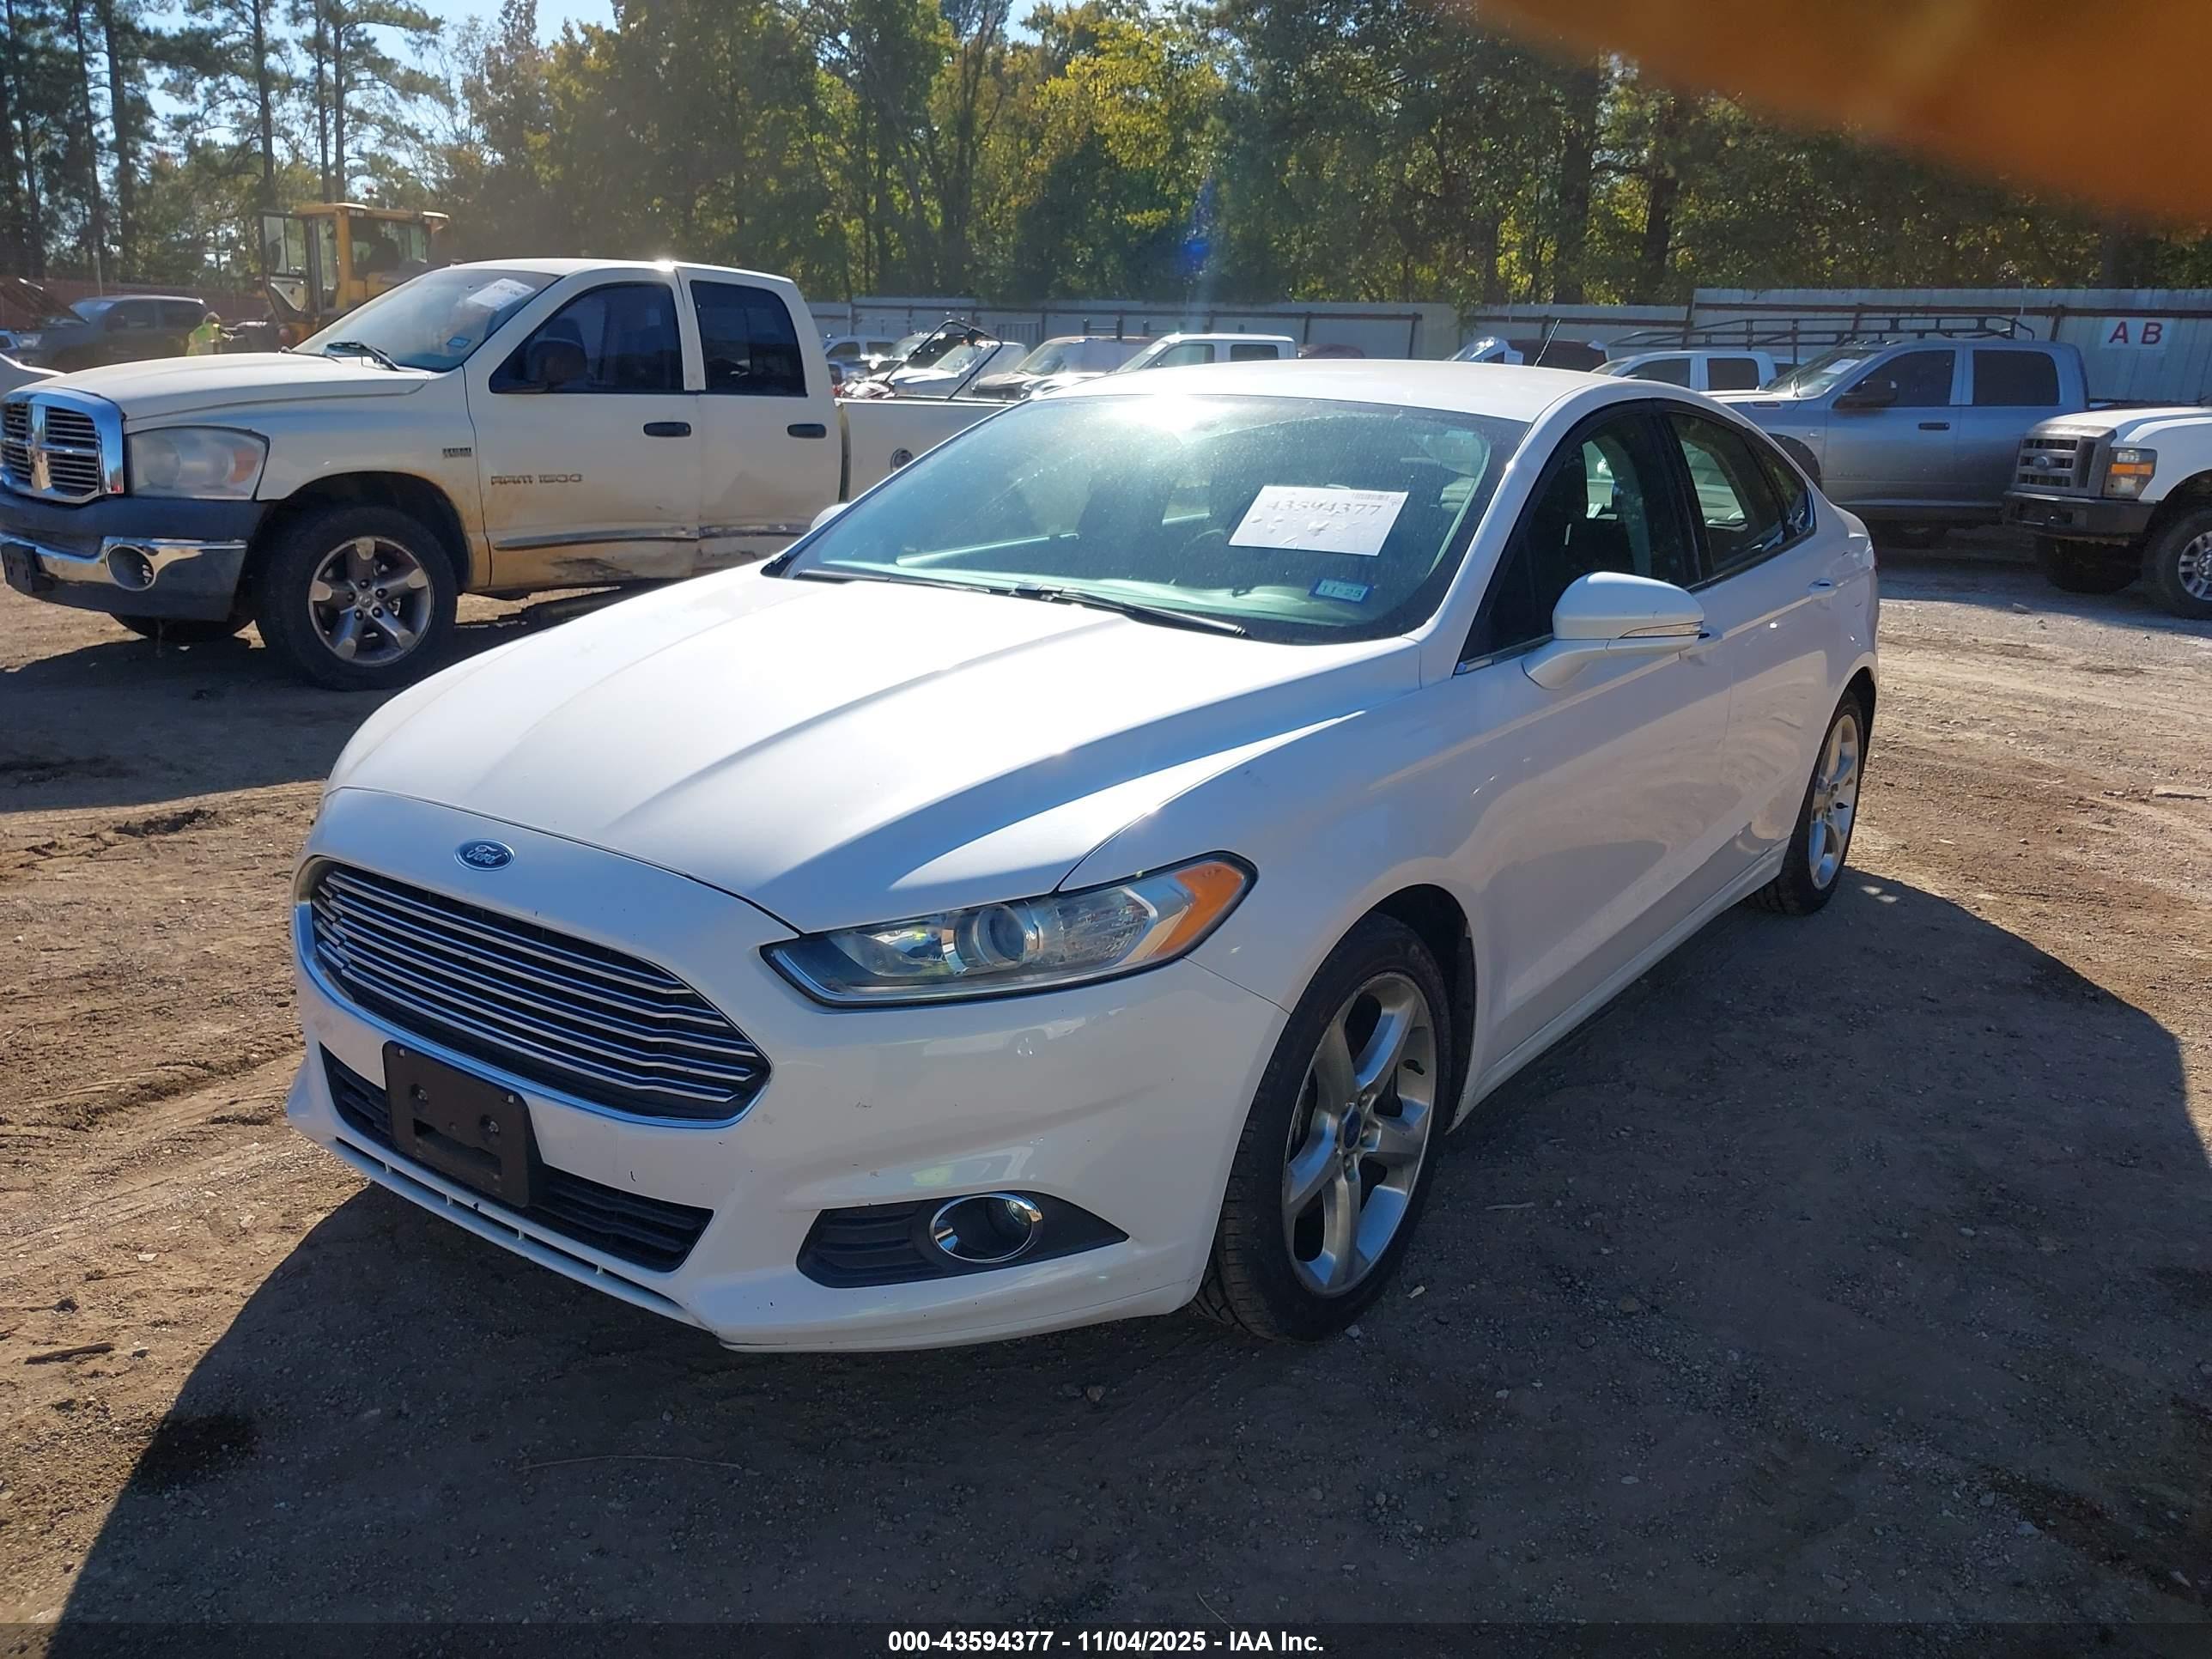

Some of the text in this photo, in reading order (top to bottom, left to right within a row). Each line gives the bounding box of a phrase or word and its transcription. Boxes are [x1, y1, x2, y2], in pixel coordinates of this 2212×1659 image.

[2108, 320, 2163, 345] A B
[490, 474, 534, 486] RAM
[466, 844, 502, 865] Ford
